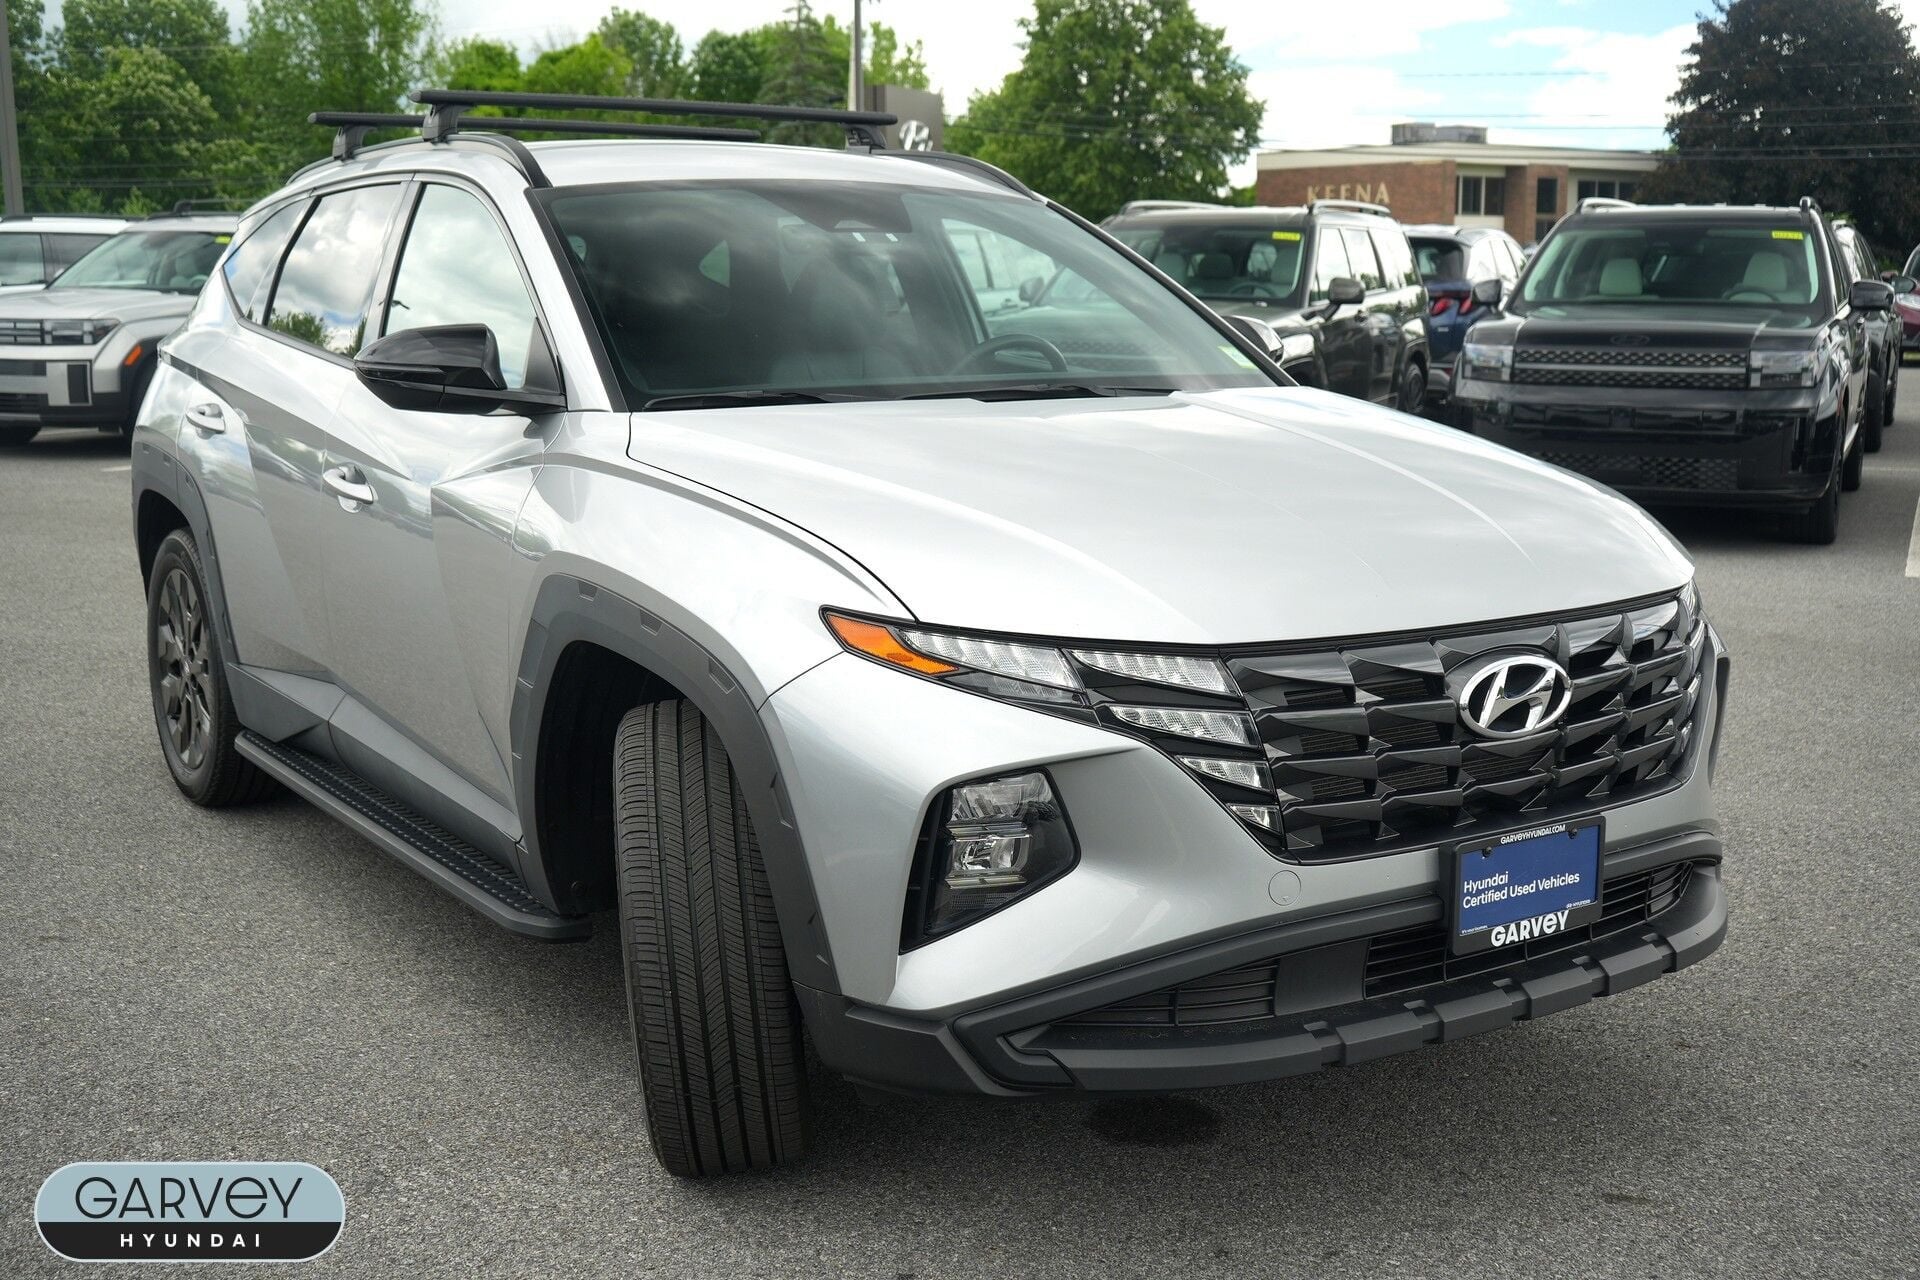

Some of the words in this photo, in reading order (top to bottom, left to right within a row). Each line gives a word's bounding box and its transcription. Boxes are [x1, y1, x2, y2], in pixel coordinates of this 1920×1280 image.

[1307, 182, 1390, 204] KEENA
[1463, 887, 1508, 909] Certified
[1509, 880, 1536, 898] Used
[1538, 872, 1580, 891] Vehicles
[1464, 871, 1509, 894] Hyundai
